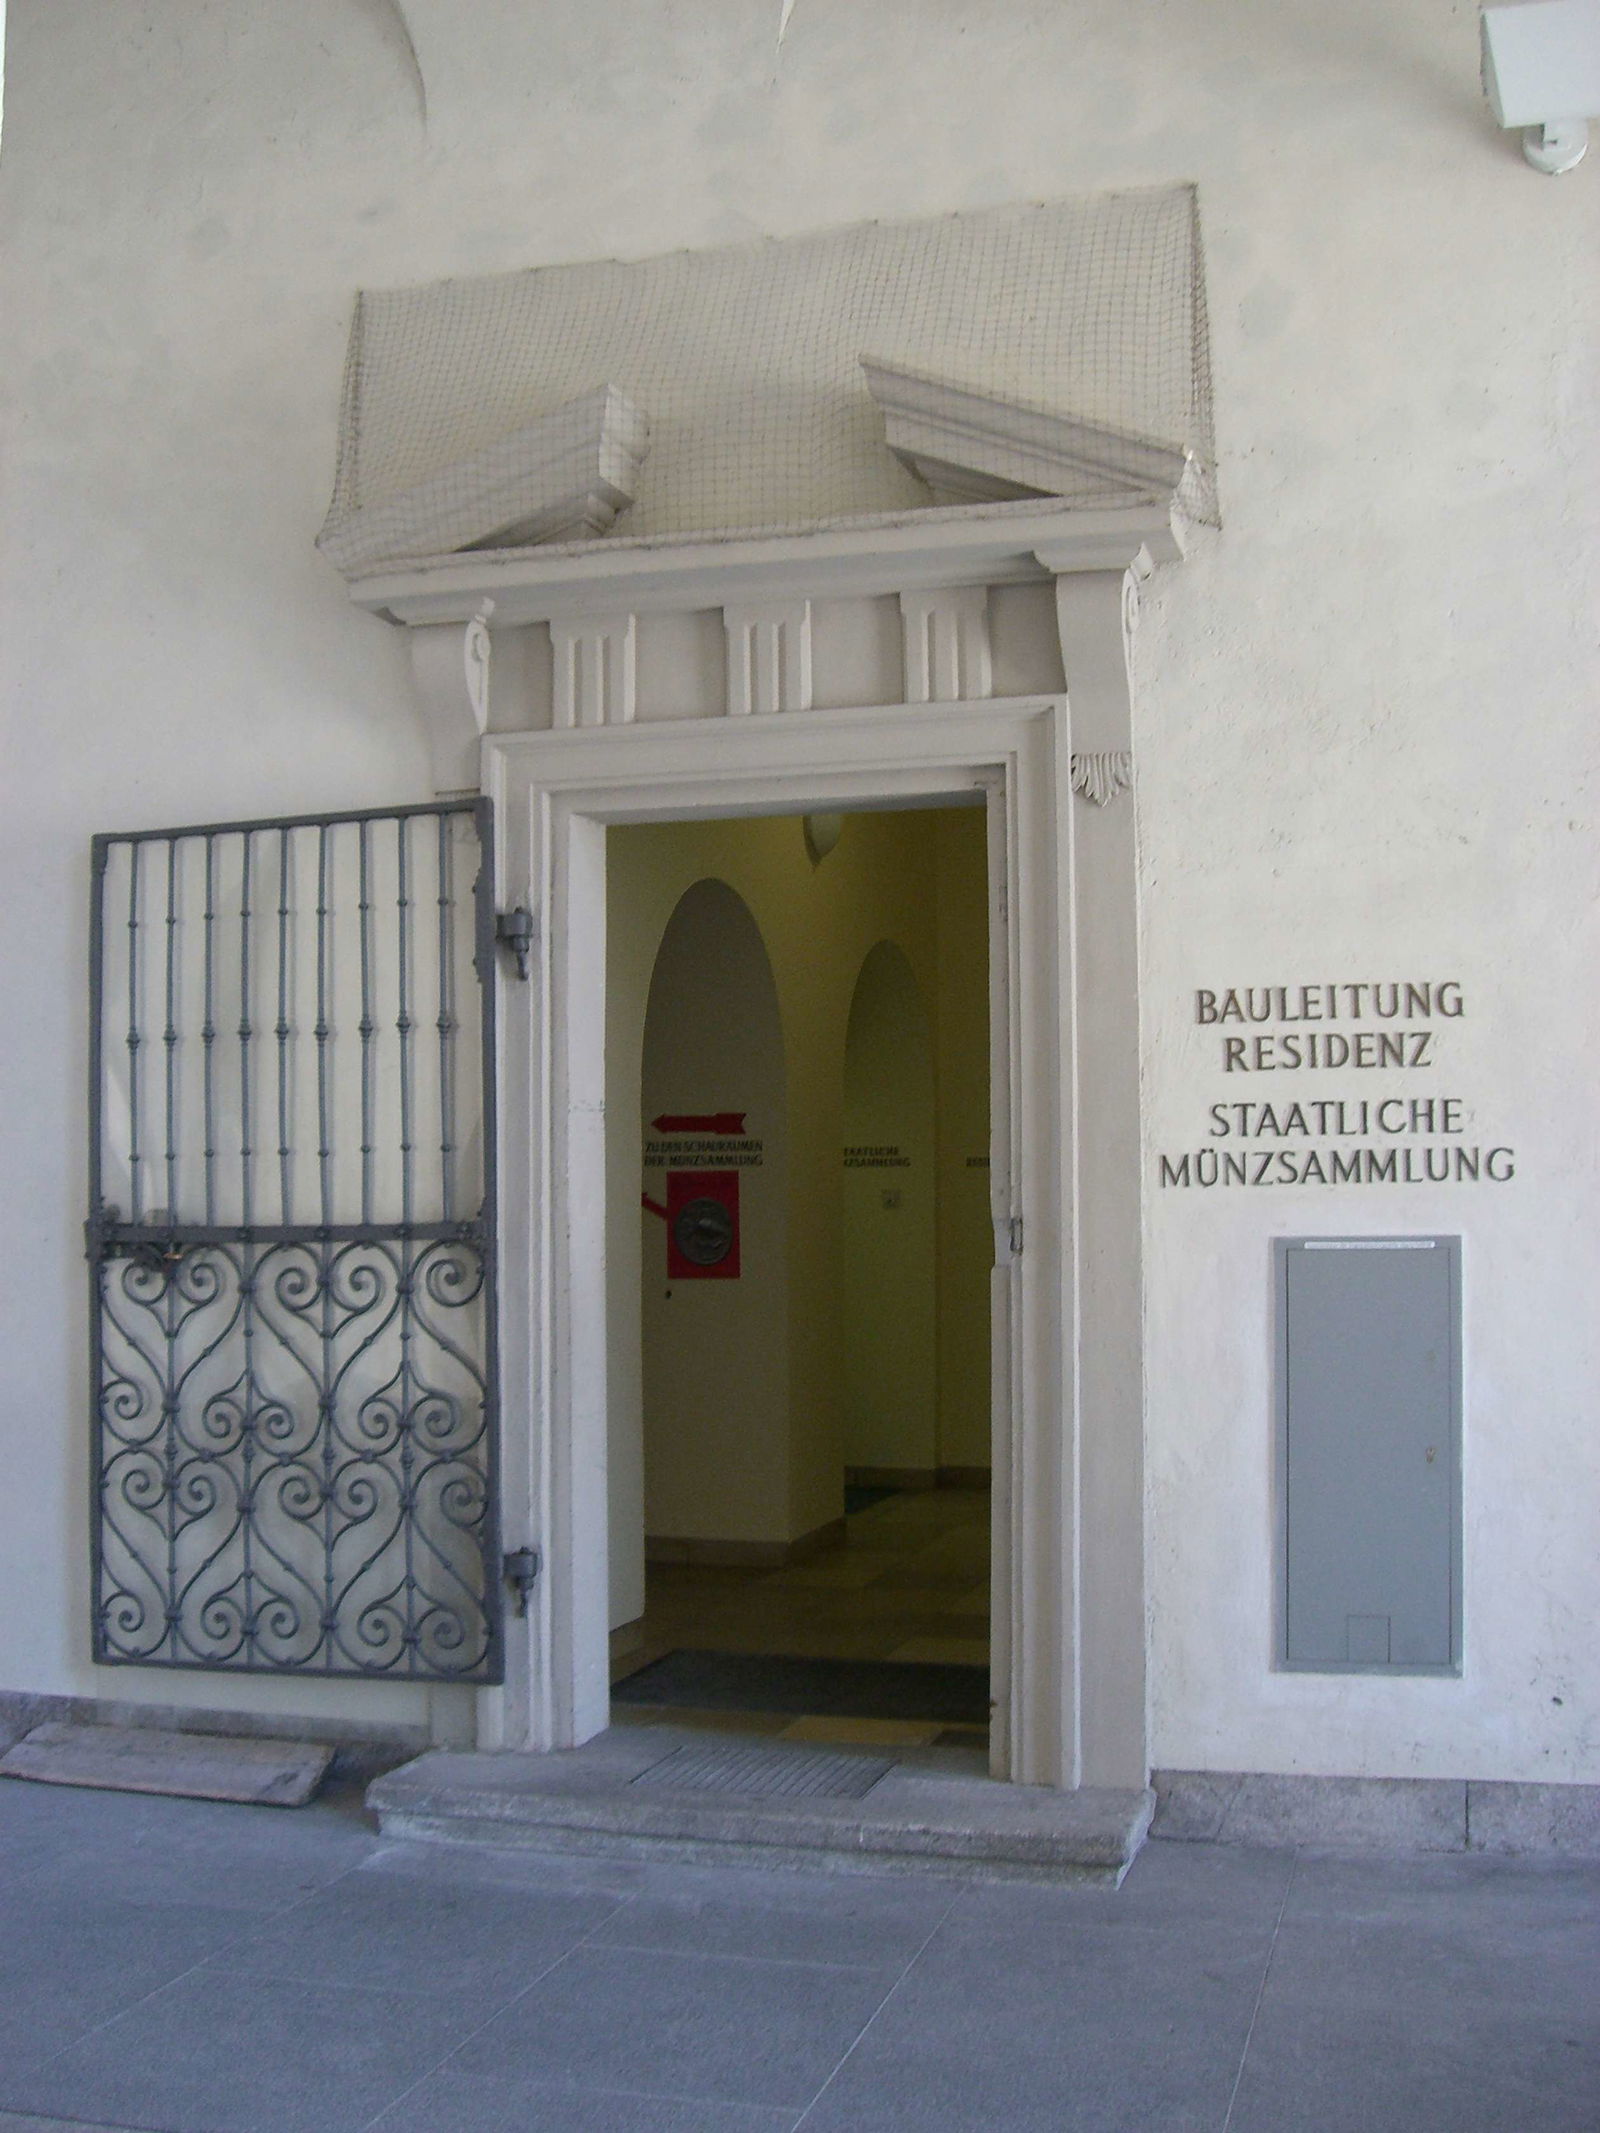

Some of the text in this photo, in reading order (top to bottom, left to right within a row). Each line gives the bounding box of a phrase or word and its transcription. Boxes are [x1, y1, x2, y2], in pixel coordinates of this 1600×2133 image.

[1196, 981, 1465, 1025] BAULEITUNG
[1224, 1031, 1433, 1072] RESIDENZ
[1209, 1098, 1465, 1138] STAATLICHE
[1160, 1147, 1515, 1189] MÜNZSAMMLUNG
